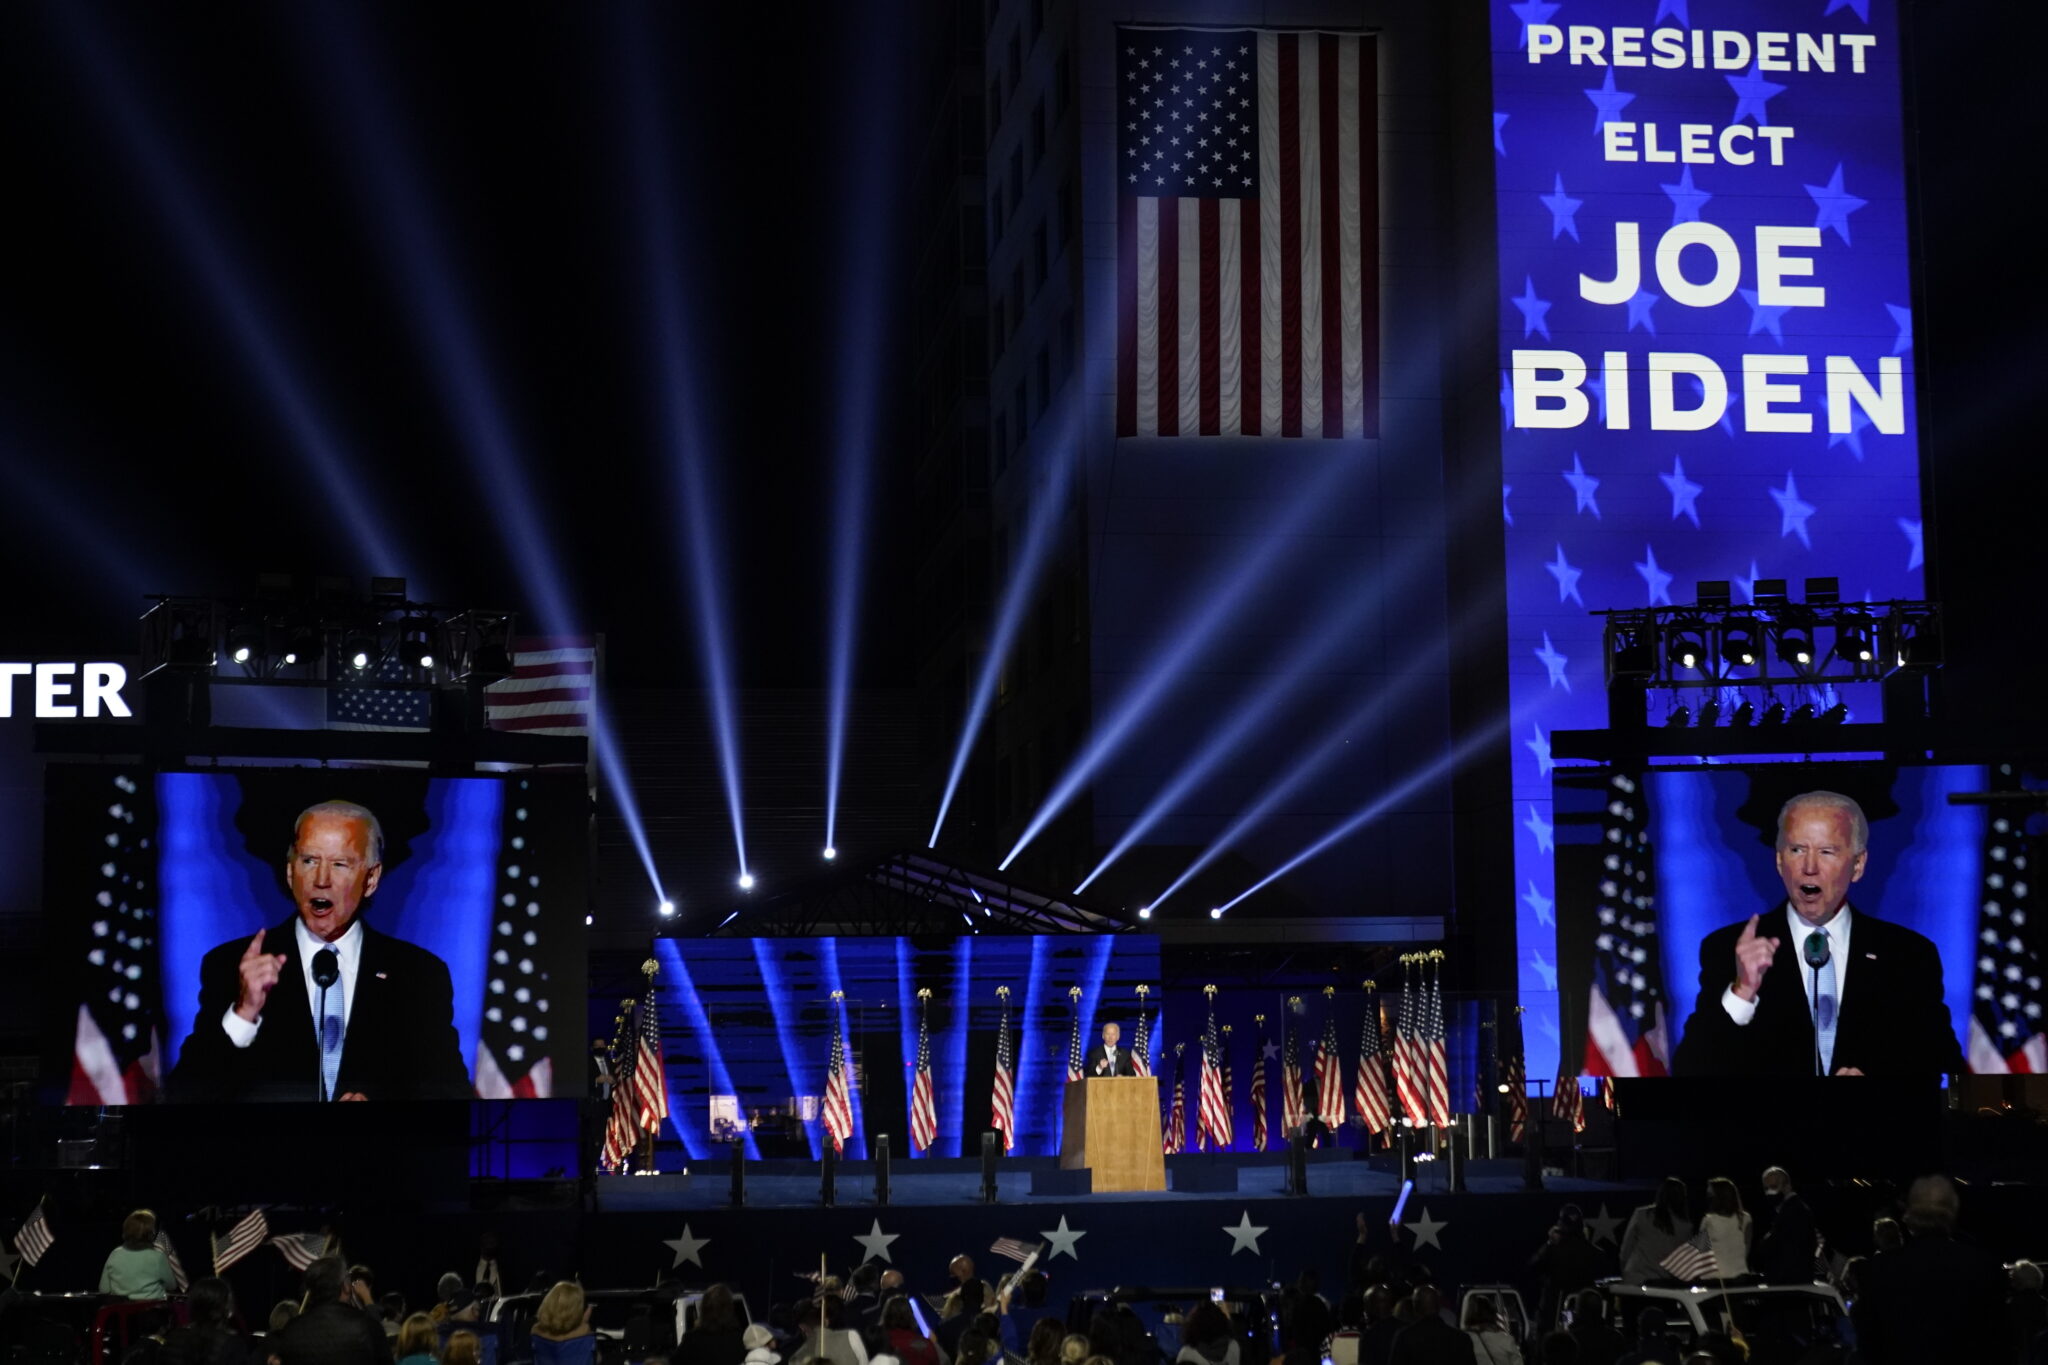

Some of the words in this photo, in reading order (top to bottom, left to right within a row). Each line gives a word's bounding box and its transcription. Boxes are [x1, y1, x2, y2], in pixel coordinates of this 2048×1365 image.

[1527, 24, 1876, 74] PRESIDENT
[1603, 121, 1795, 166] ELECT
[1579, 221, 1826, 308] JOE
[1511, 349, 1906, 435] BIDEN
